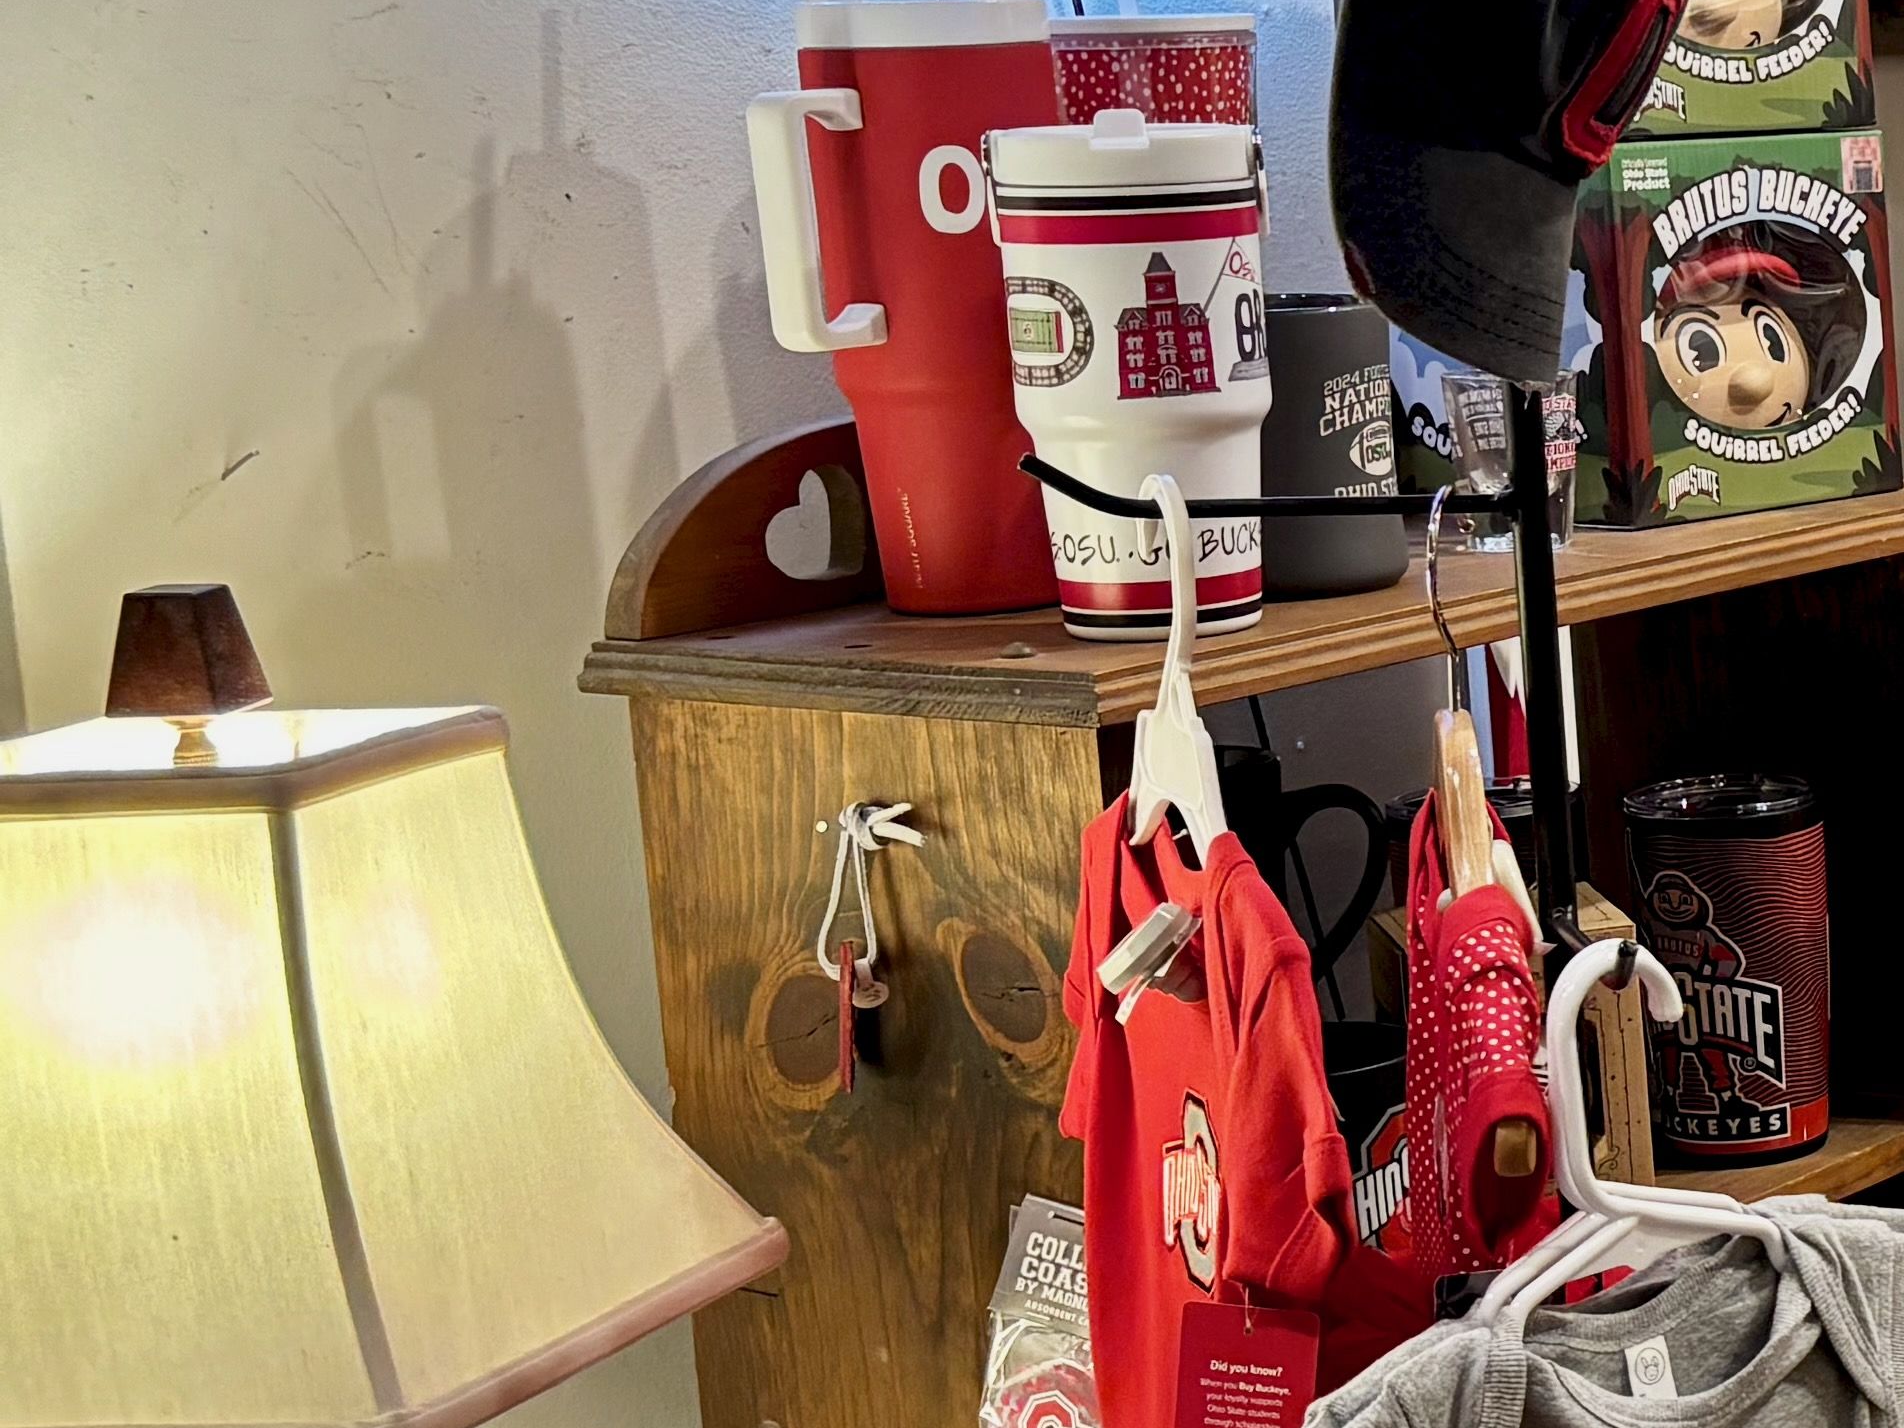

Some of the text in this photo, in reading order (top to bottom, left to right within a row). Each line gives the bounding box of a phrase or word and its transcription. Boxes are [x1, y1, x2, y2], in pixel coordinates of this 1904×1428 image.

[1756, 21, 1833, 80] FEEDER!
[1623, 176, 1670, 191] Product
[1652, 167, 1868, 259] BRUTUS BUCKEYE
[1323, 377, 1361, 396] 2024
[1791, 387, 1865, 454] FEEDER!
[1209, 1358, 1284, 1378] Did you know?
